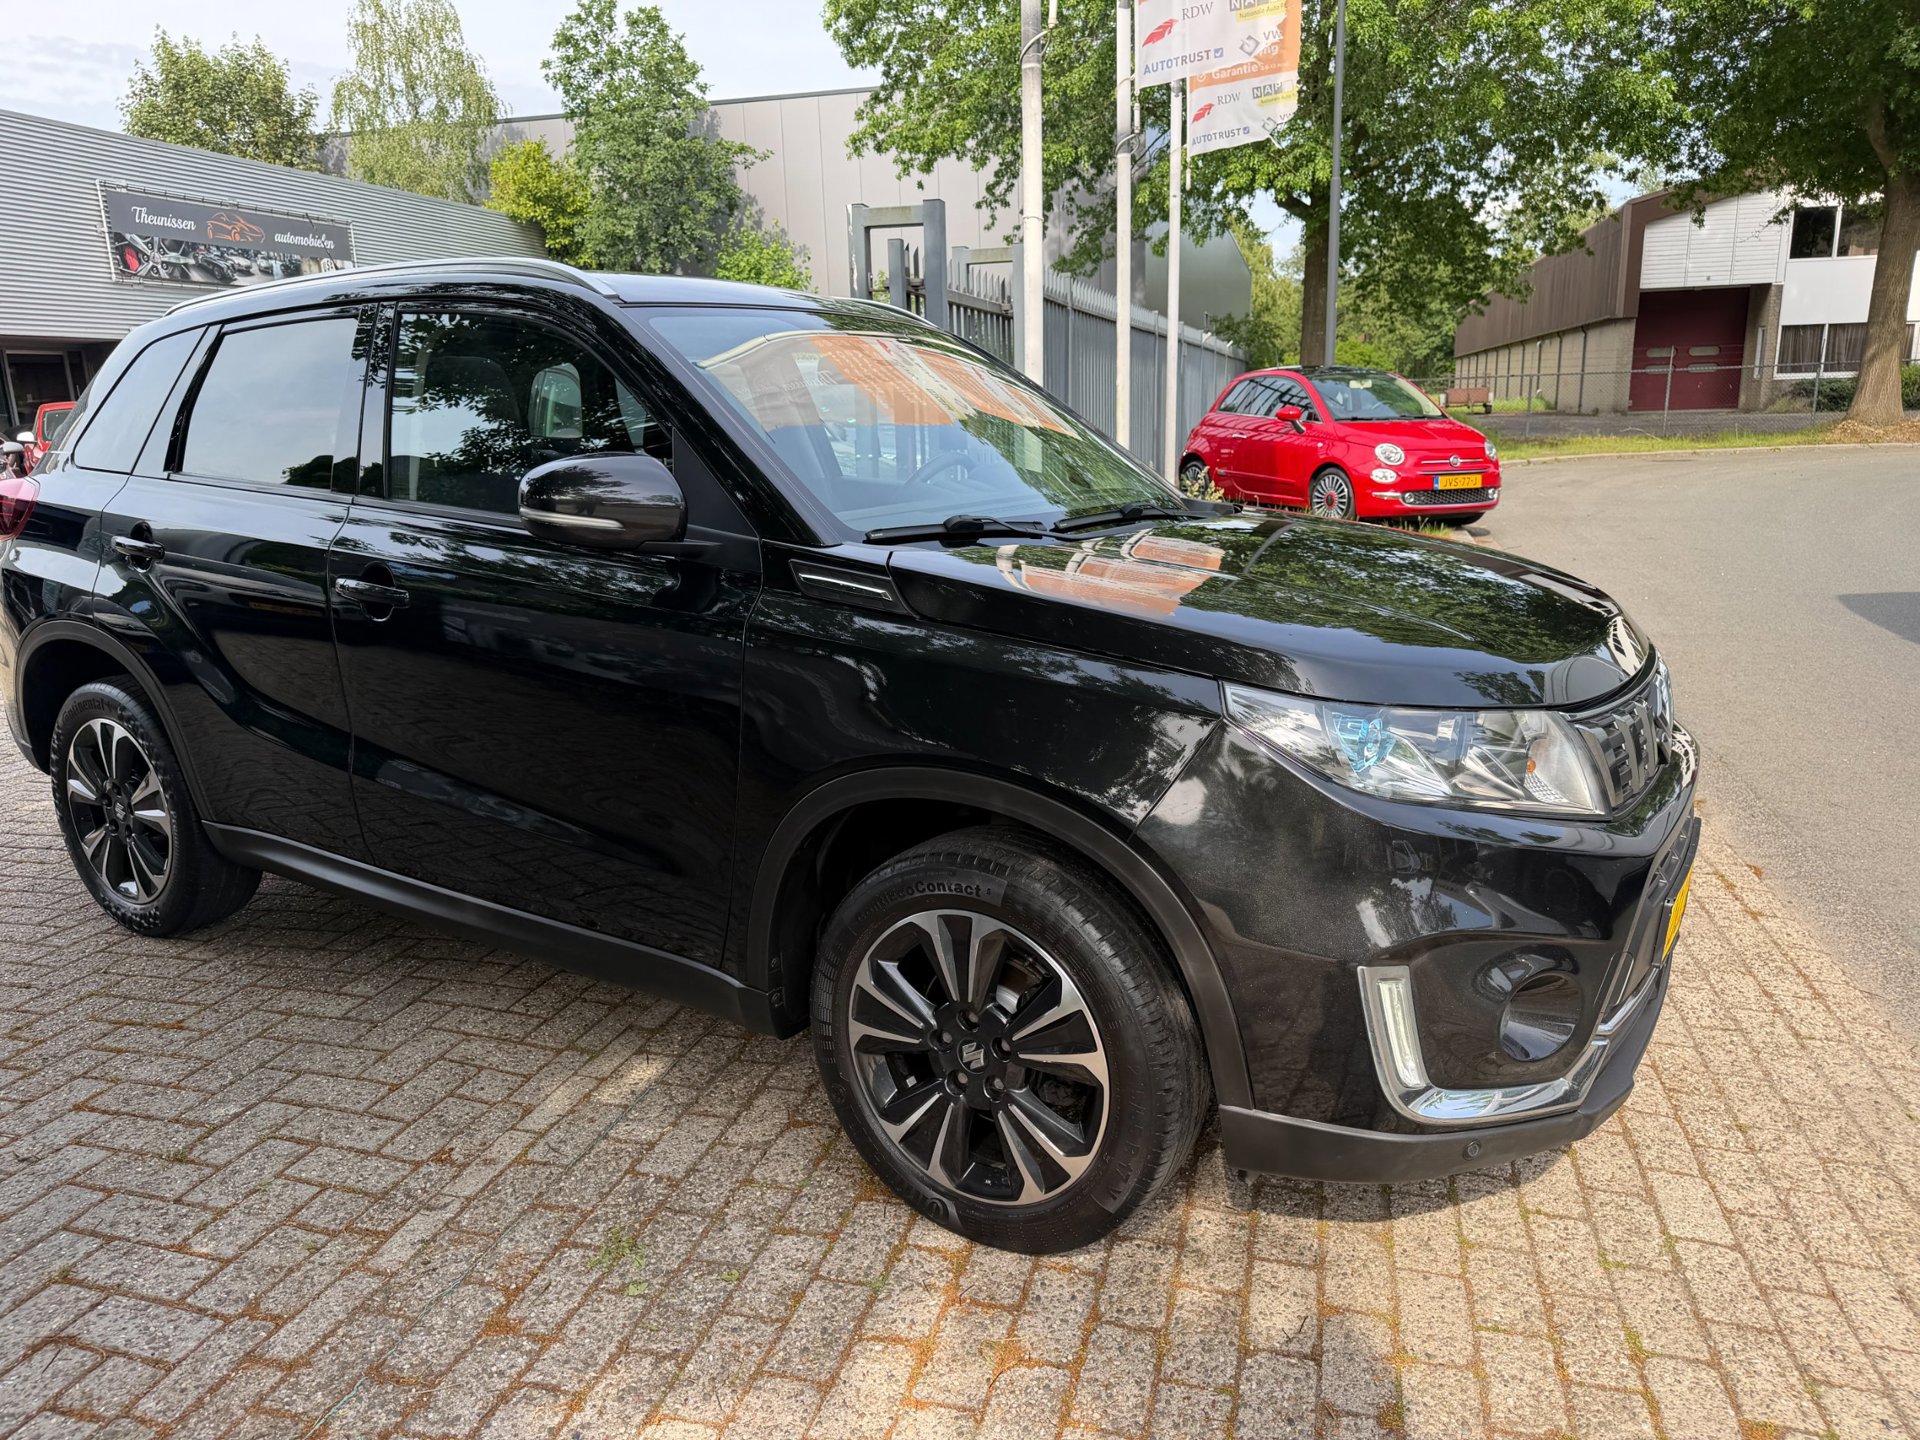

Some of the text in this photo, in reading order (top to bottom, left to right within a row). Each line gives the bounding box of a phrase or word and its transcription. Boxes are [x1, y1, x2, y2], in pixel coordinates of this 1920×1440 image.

[1181, 2, 1213, 20] RDW
[1143, 49, 1212, 75] AUTOTRUST
[1211, 63, 1259, 79] Garantie
[1217, 92, 1241, 105] RDW
[1191, 127, 1242, 146] AUTOTRUST
[131, 206, 335, 249] Theunissen automobielen
